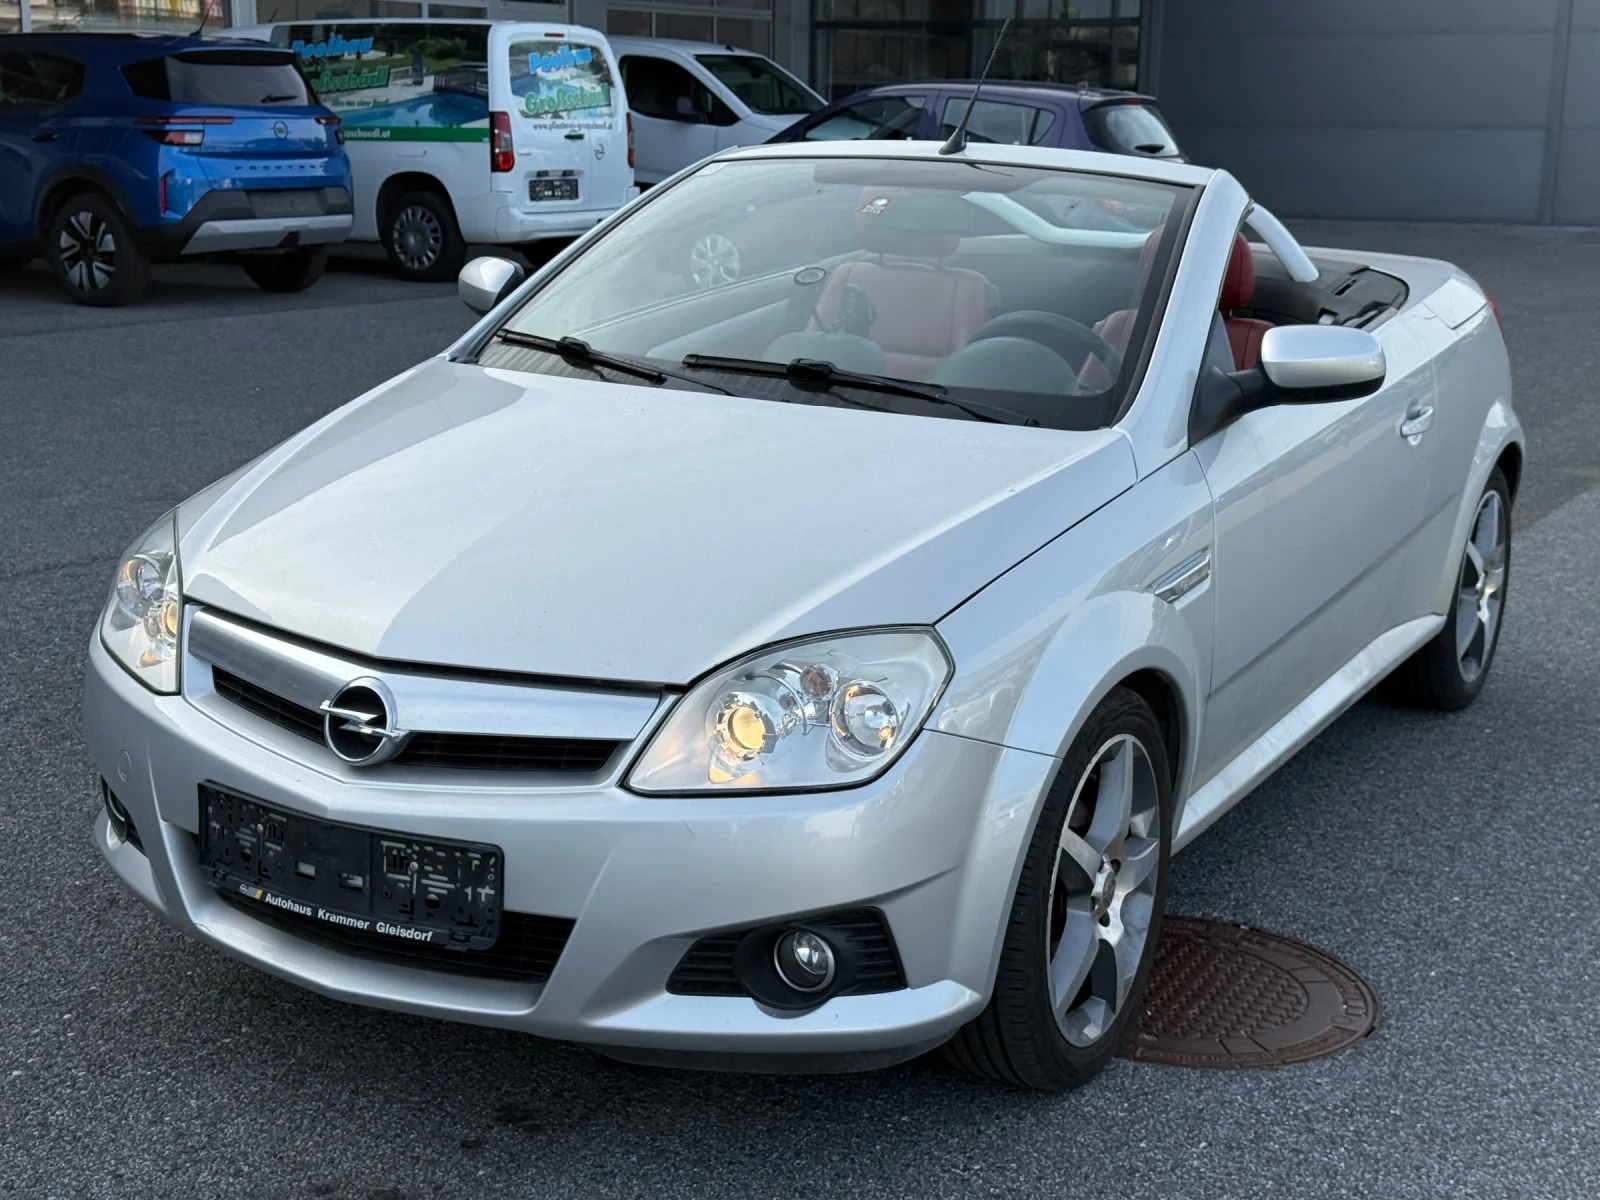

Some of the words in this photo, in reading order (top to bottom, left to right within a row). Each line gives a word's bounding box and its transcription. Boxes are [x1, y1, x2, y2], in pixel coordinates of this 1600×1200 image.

[528, 45, 592, 75] Poolbau
[264, 892, 312, 916] Autohaus
[317, 907, 370, 930] Krammer
[376, 921, 433, 942] Gleisdorf
